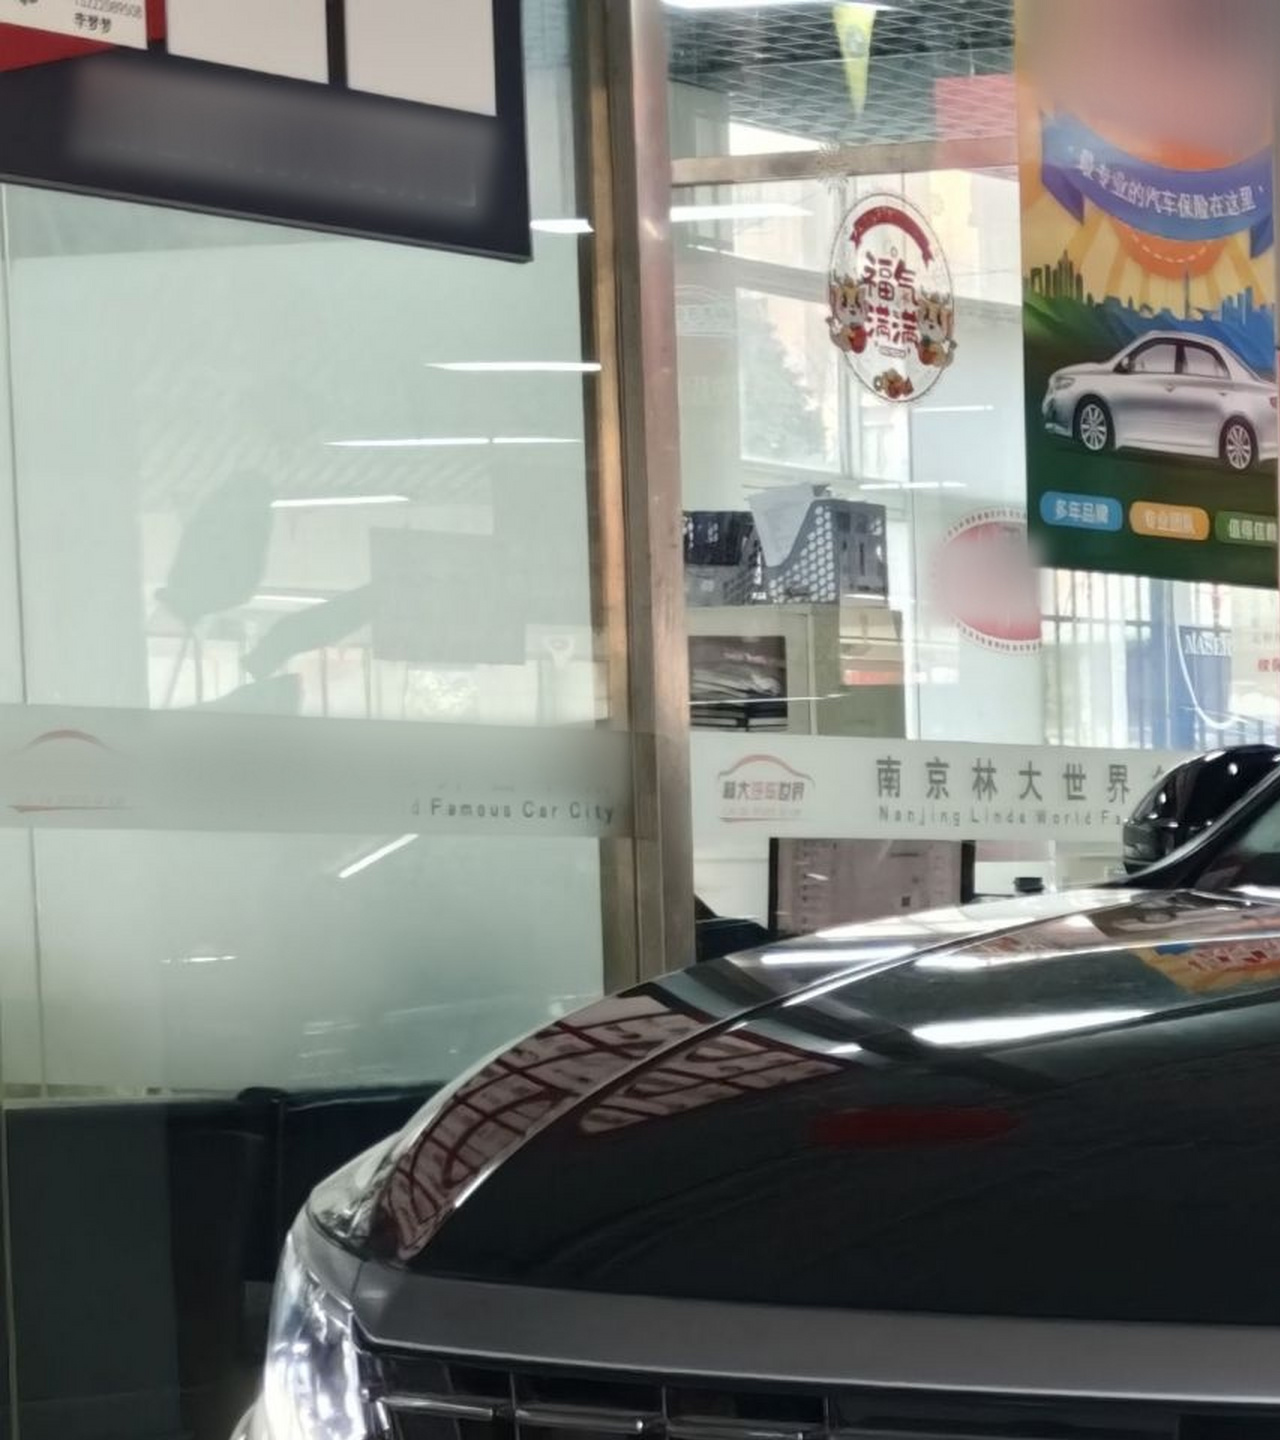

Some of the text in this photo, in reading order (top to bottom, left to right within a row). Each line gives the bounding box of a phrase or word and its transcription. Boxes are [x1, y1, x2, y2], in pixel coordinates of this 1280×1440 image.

[876, 755, 1166, 804] 南京林大世界
[430, 797, 512, 817] Famous
[522, 800, 559, 818] Car
[569, 801, 614, 824] City
[879, 805, 961, 827] Nanjing
[1101, 809, 1126, 826] Fa
